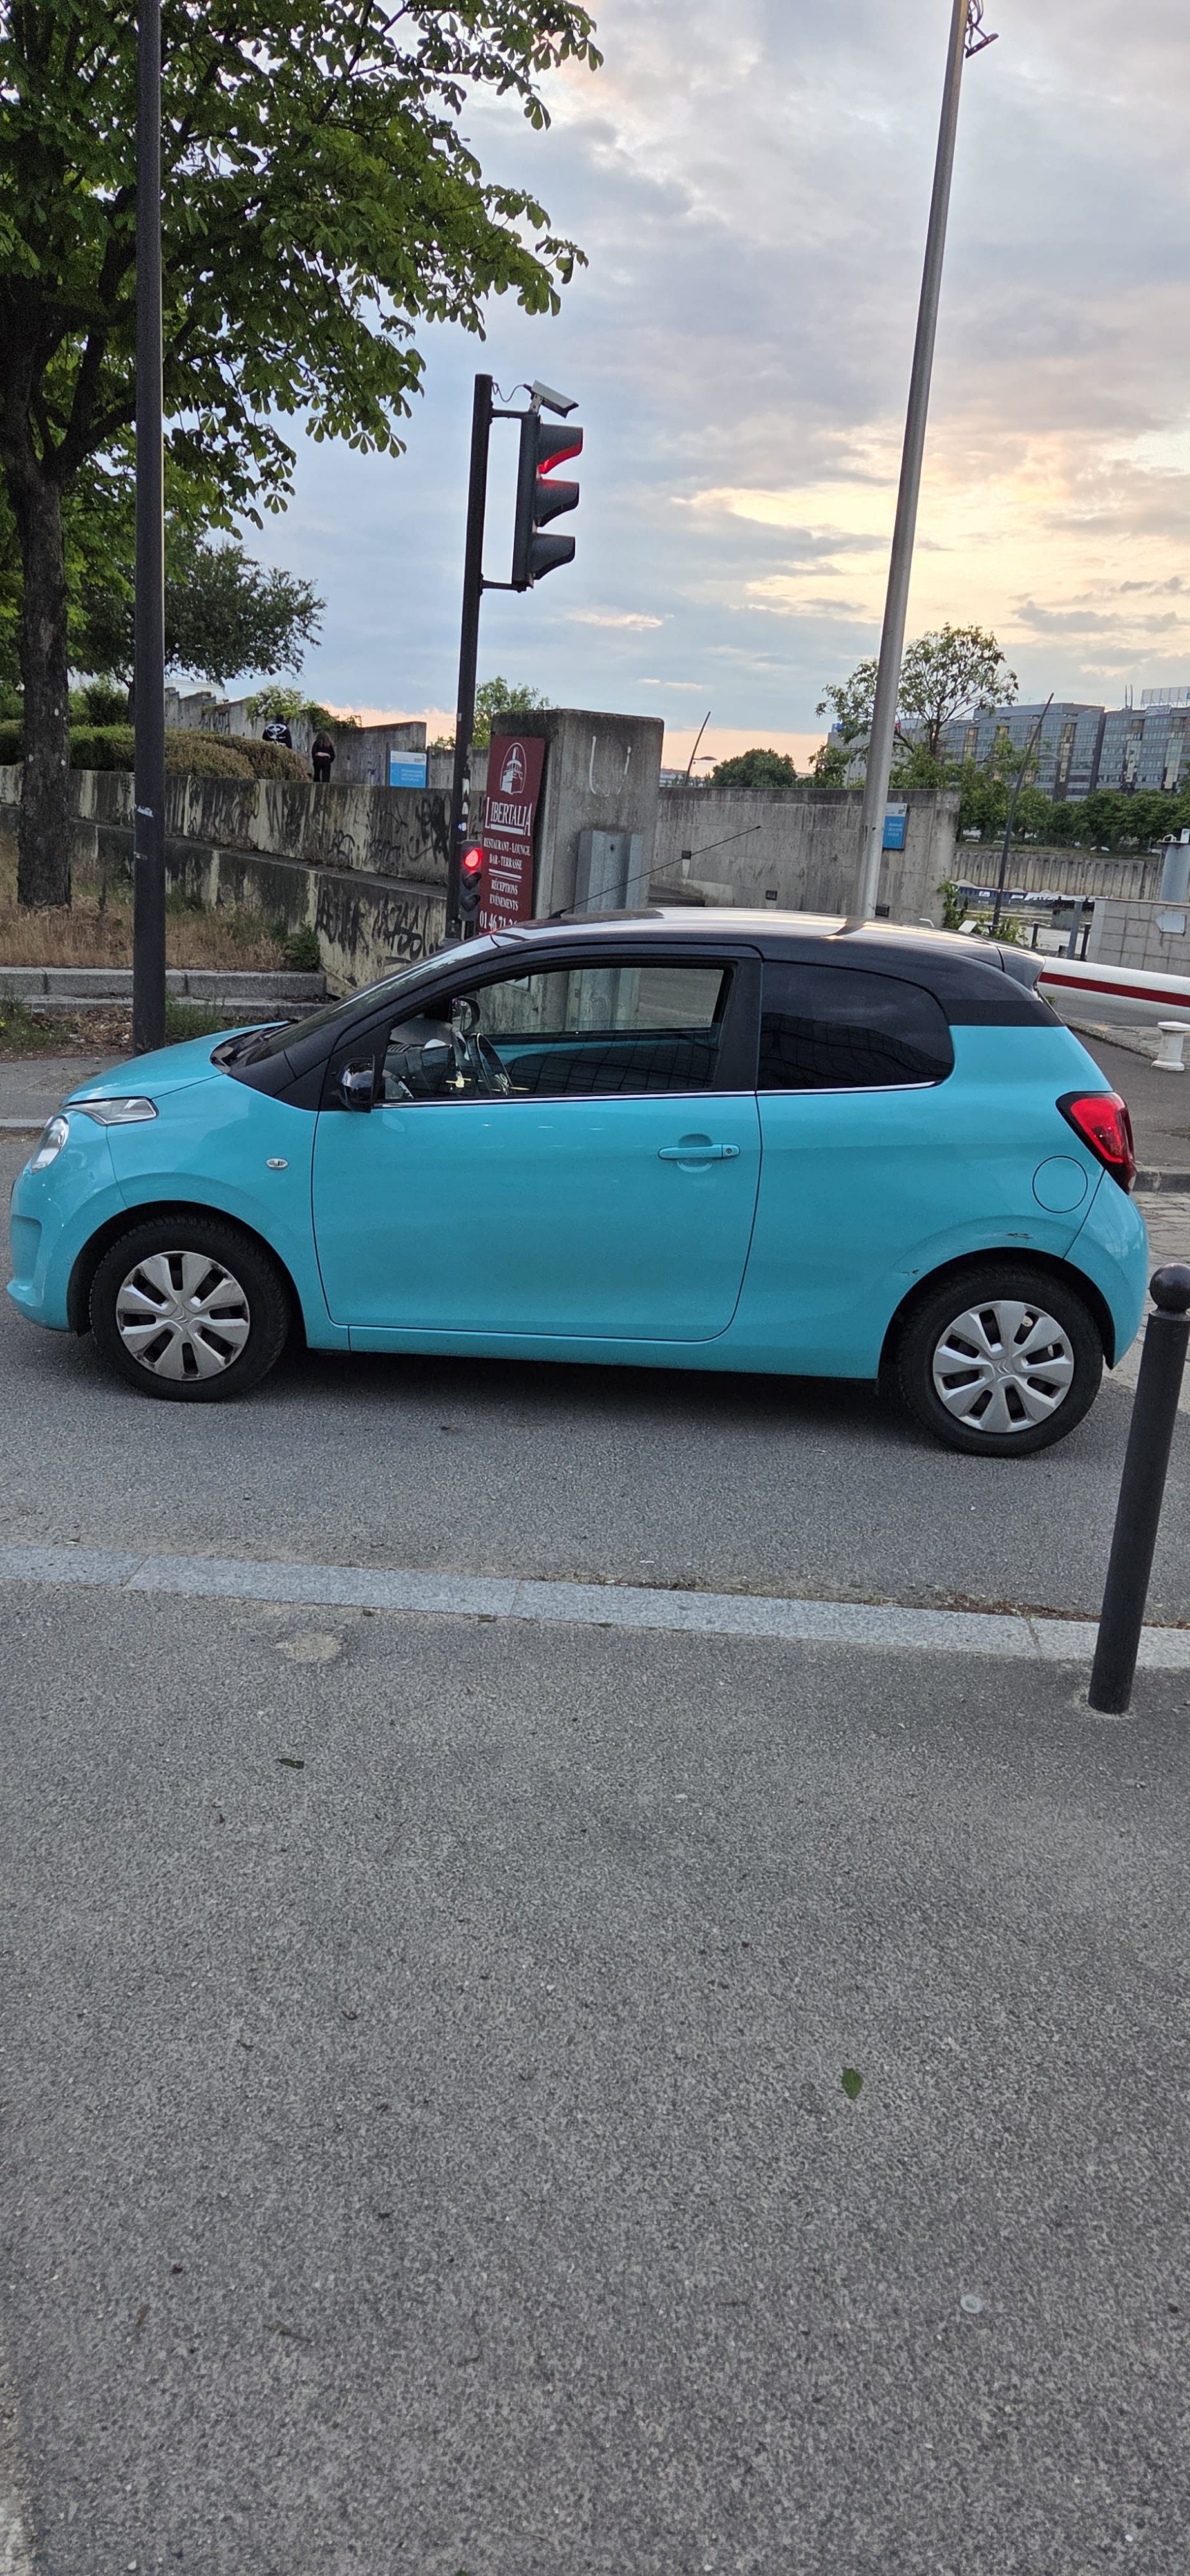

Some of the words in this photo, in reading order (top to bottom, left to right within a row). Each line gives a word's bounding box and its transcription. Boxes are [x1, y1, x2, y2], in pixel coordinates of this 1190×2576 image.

[485, 797, 532, 836] LIBERTALIA
[489, 853, 498, 864] BAR
[479, 910, 487, 929] 01
